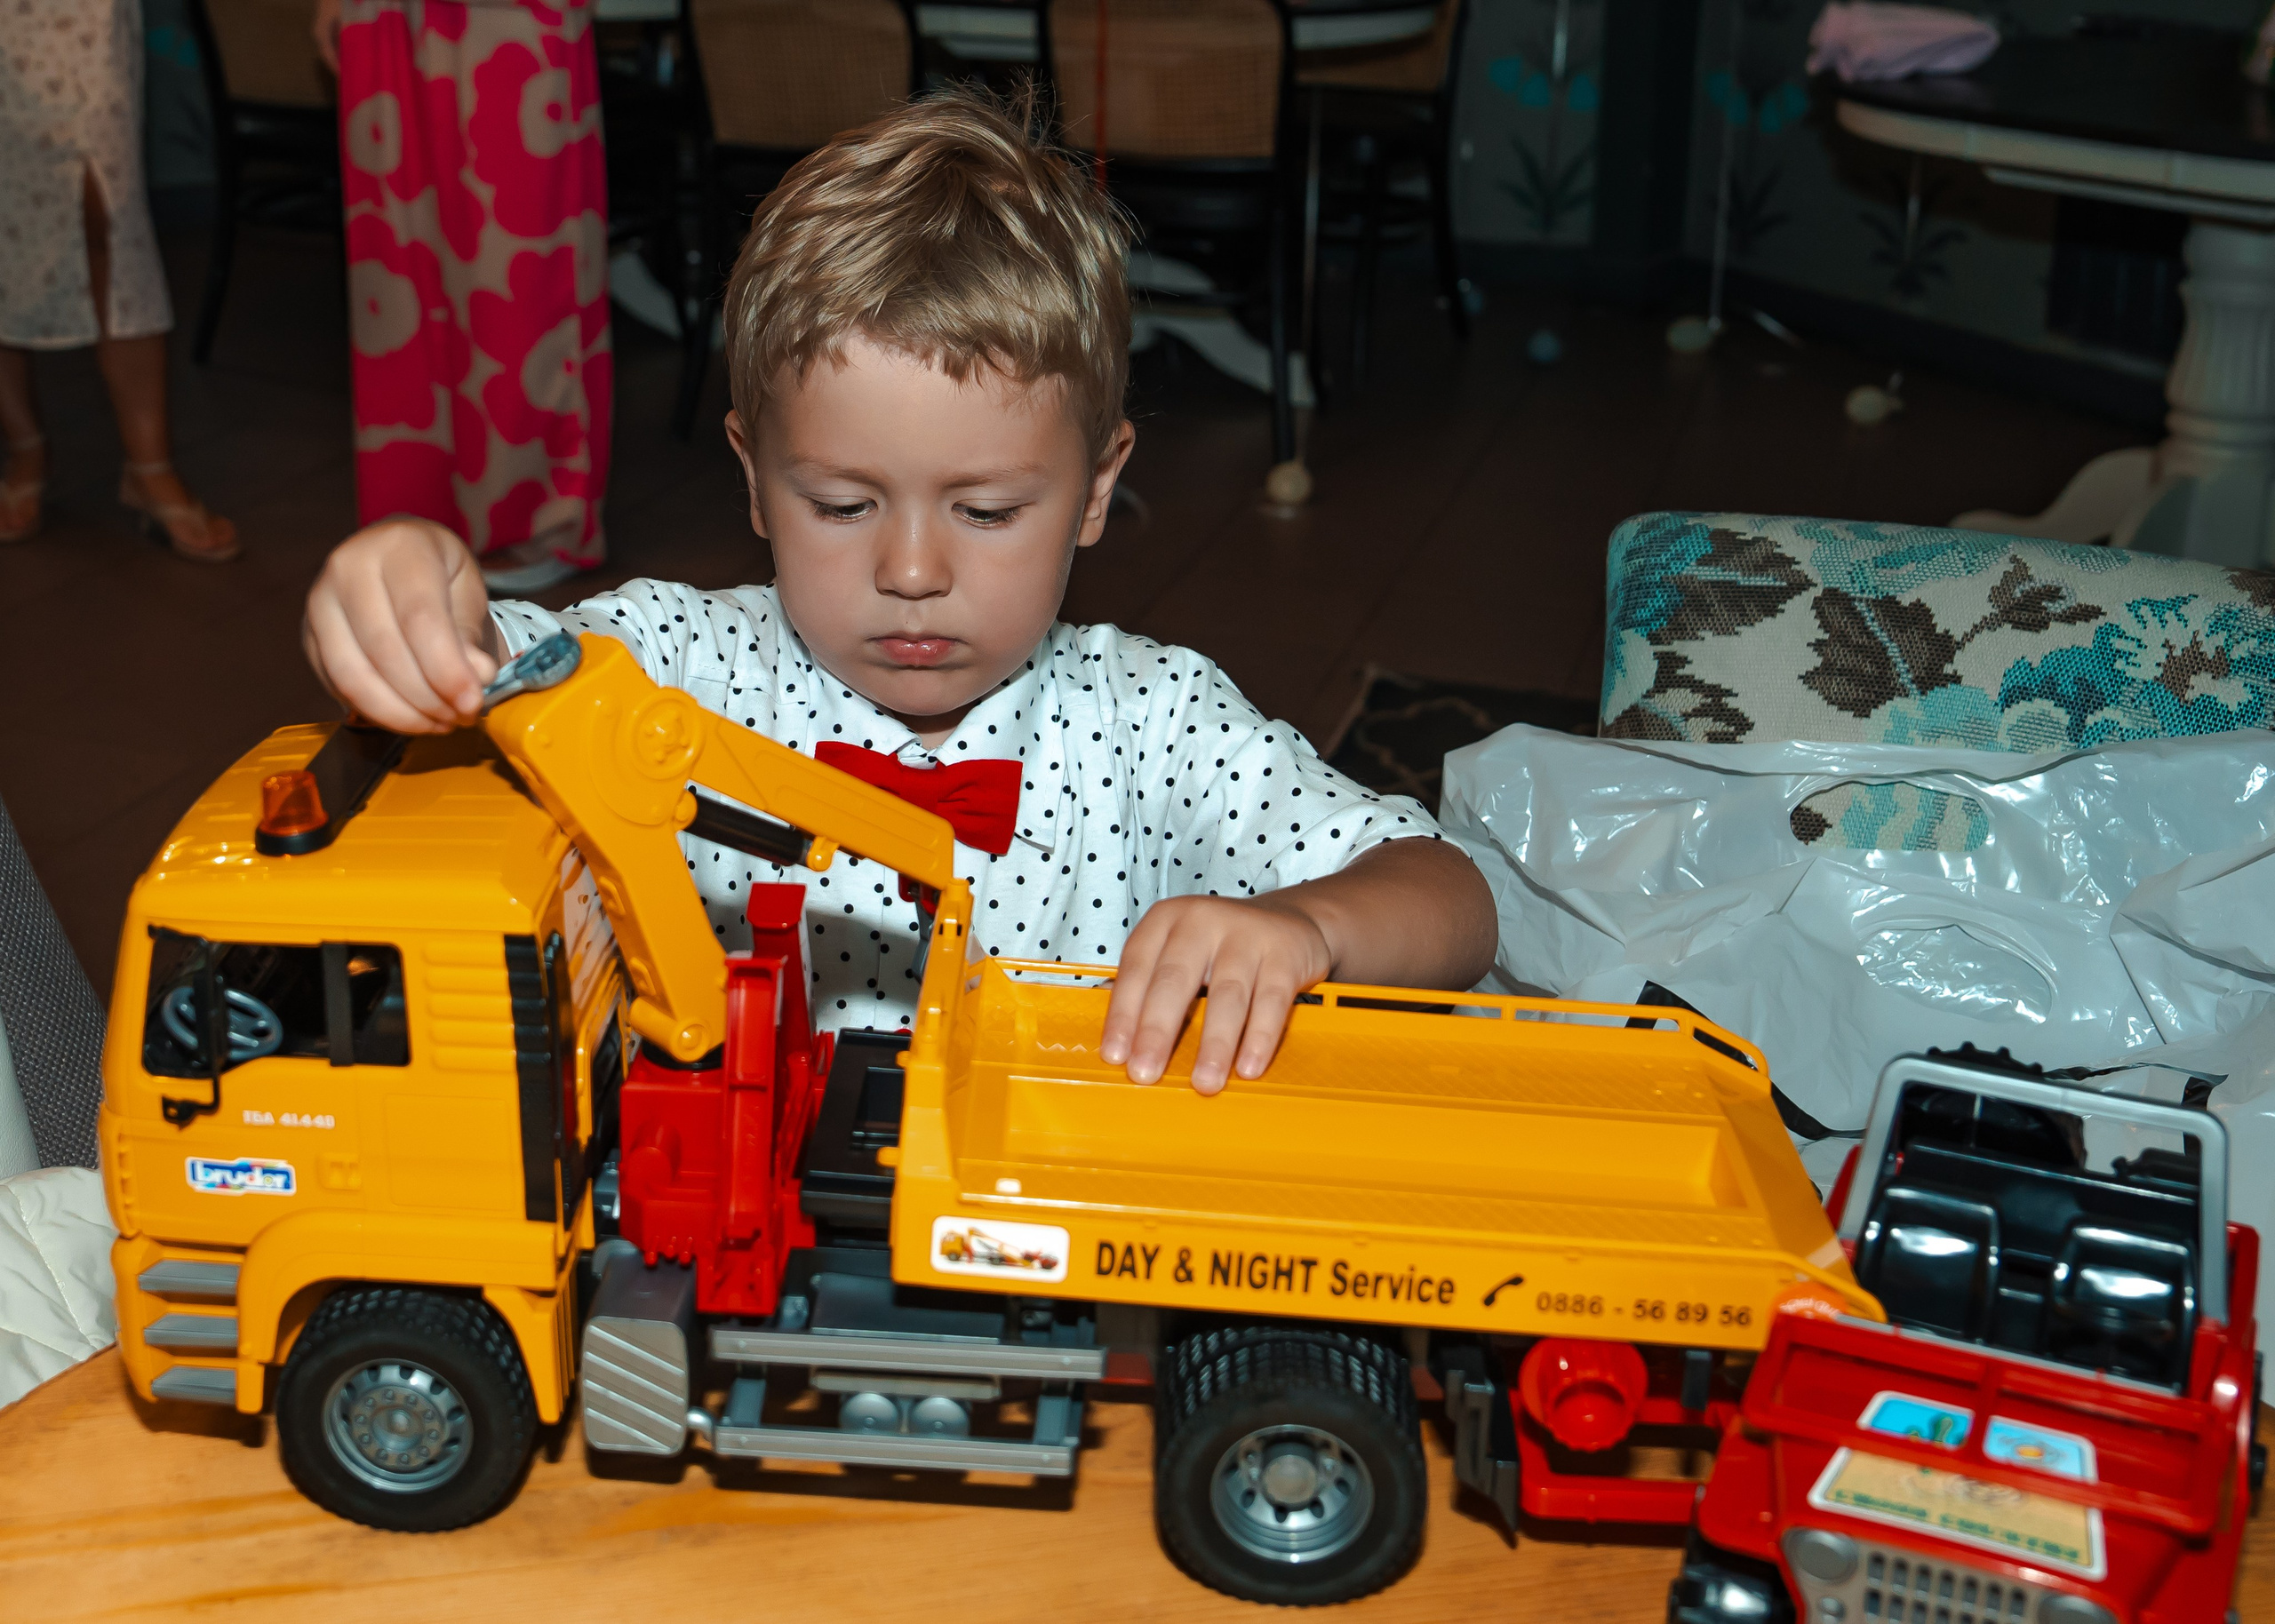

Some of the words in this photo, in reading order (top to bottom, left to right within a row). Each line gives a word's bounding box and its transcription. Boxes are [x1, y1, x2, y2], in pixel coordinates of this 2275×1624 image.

[195, 1160, 288, 1189] bruder
[1096, 1240, 1161, 1279] DAY
[1173, 1247, 1194, 1284] &
[1209, 1249, 1318, 1293] NIGHT
[1329, 1259, 1455, 1305] Service
[1536, 1291, 1603, 1316] 0886
[1633, 1299, 1665, 1320] 56
[1675, 1302, 1709, 1323] 89
[1720, 1306, 1752, 1326] 56
